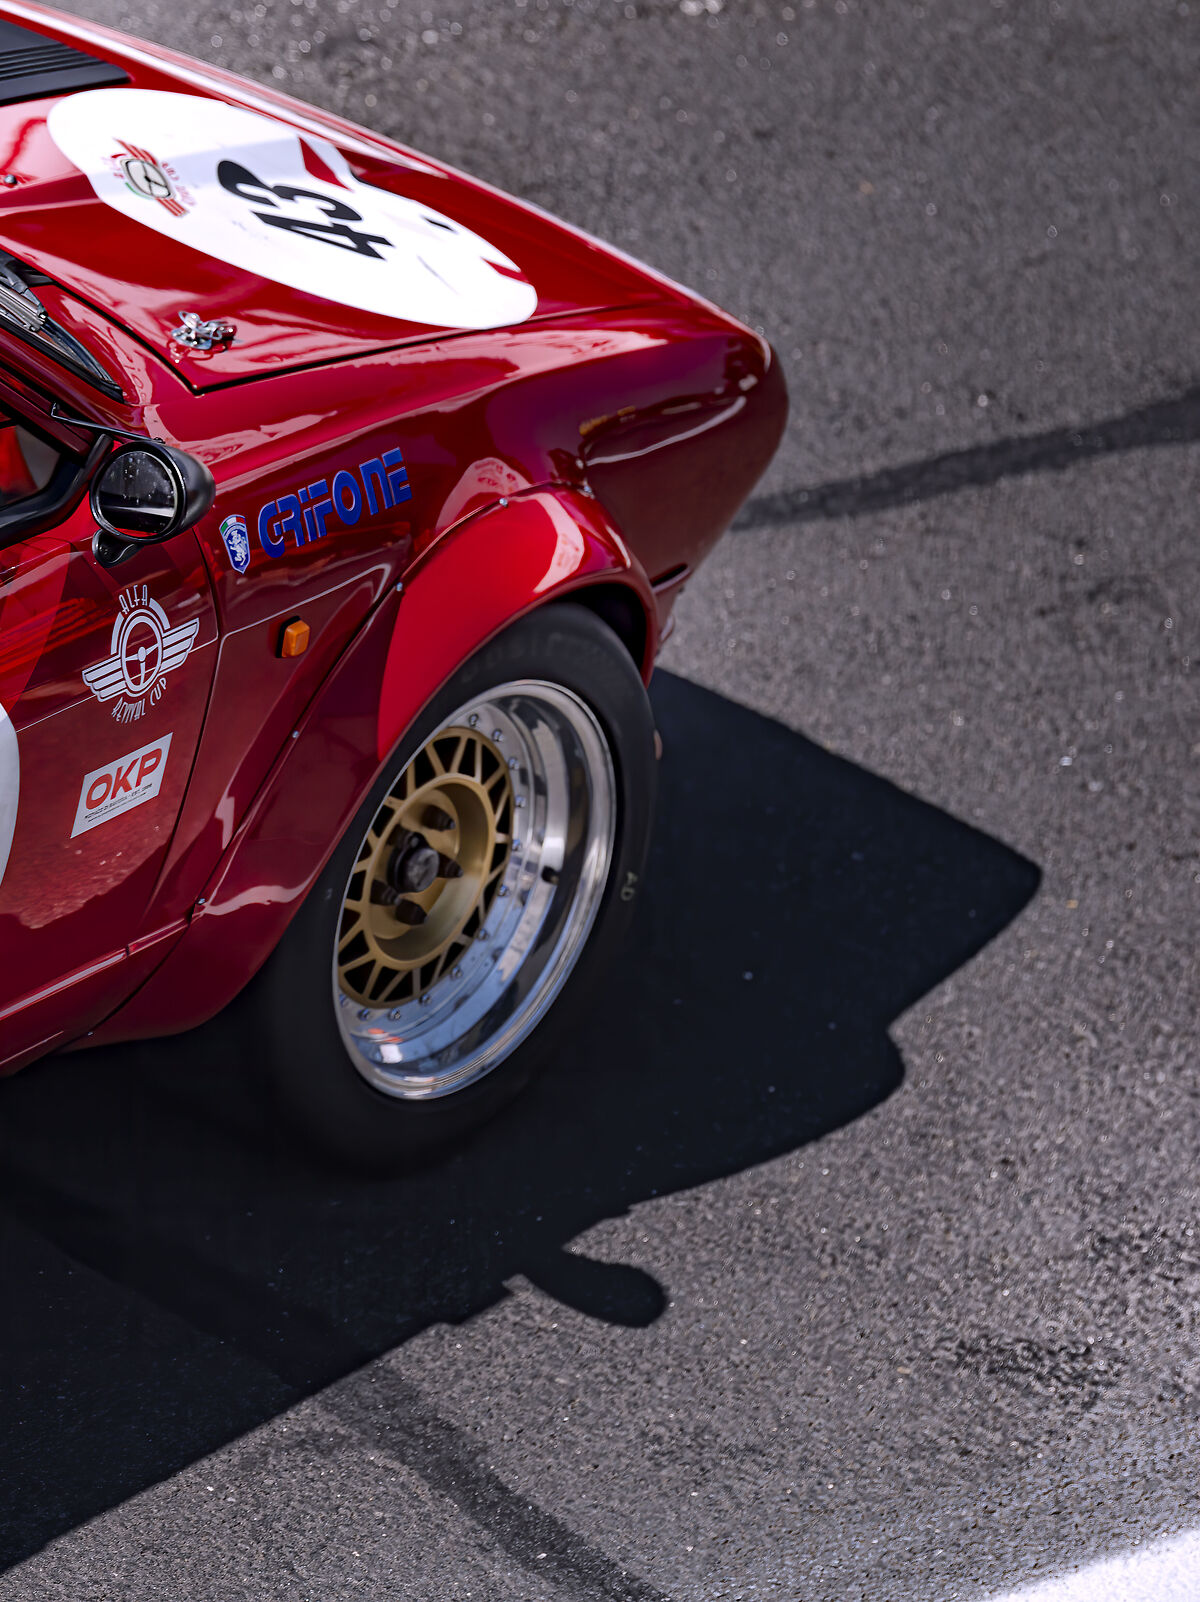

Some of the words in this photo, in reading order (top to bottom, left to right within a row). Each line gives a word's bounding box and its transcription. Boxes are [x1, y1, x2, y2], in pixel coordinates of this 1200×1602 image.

[217, 161, 394, 261] 43
[258, 447, 412, 558] GRIFONE
[119, 585, 148, 615] ALFA
[111, 697, 146, 724] REVIVAL
[149, 677, 167, 706] CUP
[86, 748, 163, 810] OKP
